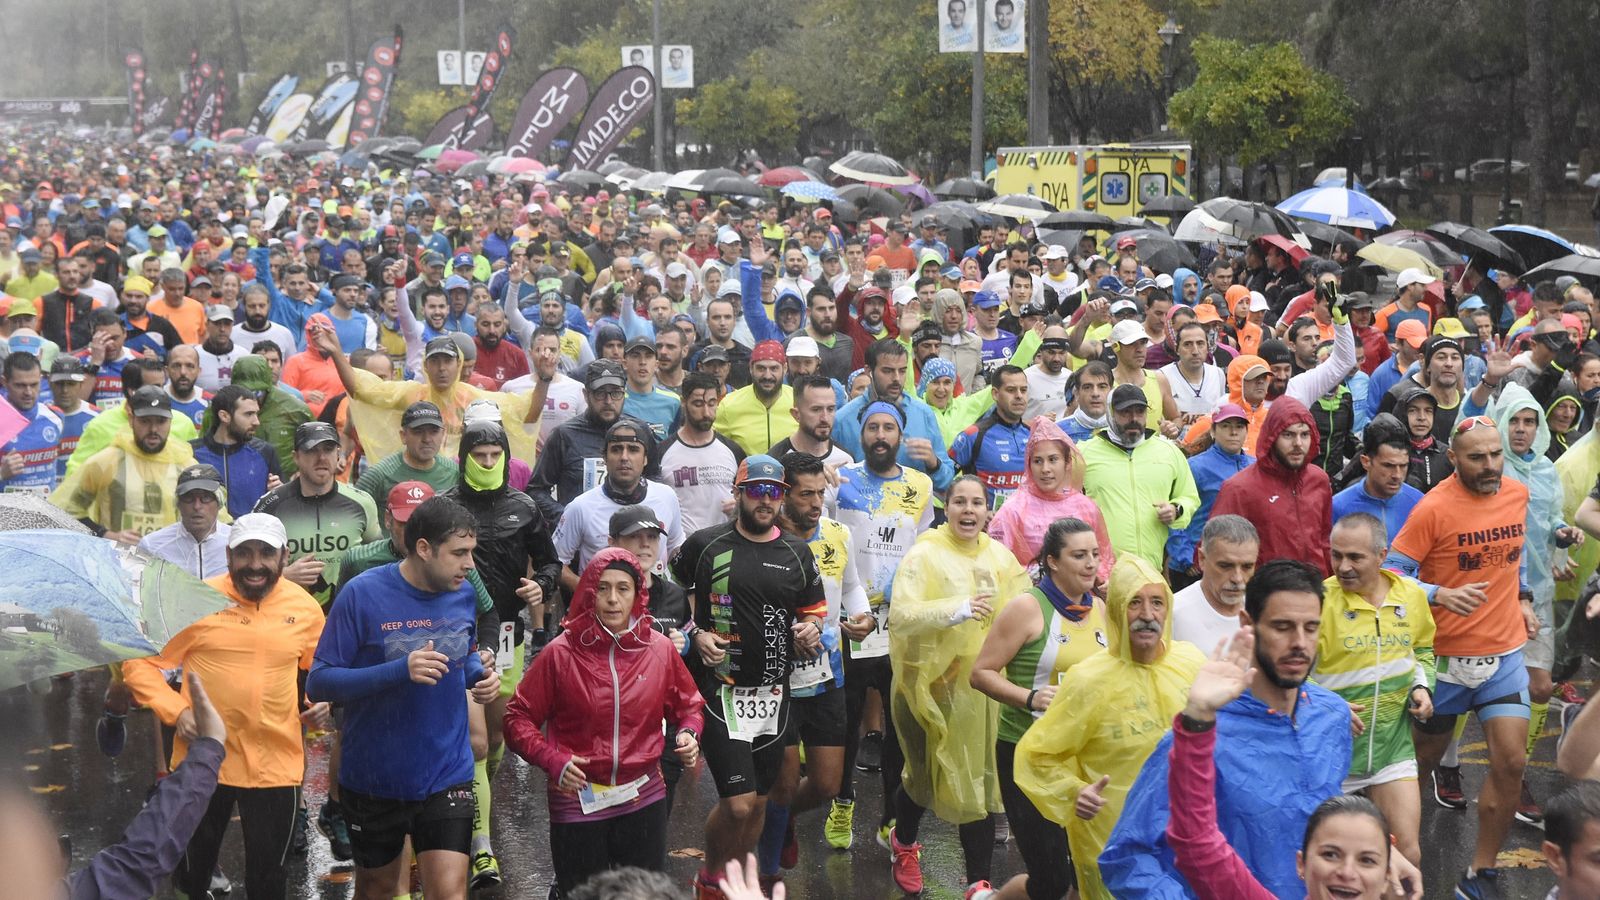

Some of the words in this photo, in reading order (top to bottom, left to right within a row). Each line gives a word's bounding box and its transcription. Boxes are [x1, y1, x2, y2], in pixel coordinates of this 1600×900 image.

[572, 76, 650, 165] IMDECO
[1119, 157, 1151, 172] DYA
[1041, 182, 1070, 209] DYA
[1457, 523, 1524, 547] FINISHER
[867, 539, 902, 551] Lorman
[380, 621, 403, 631] KEEP
[406, 619, 432, 629] GOING
[1343, 633, 1410, 649] CATALANO
[735, 699, 778, 719] 3333
